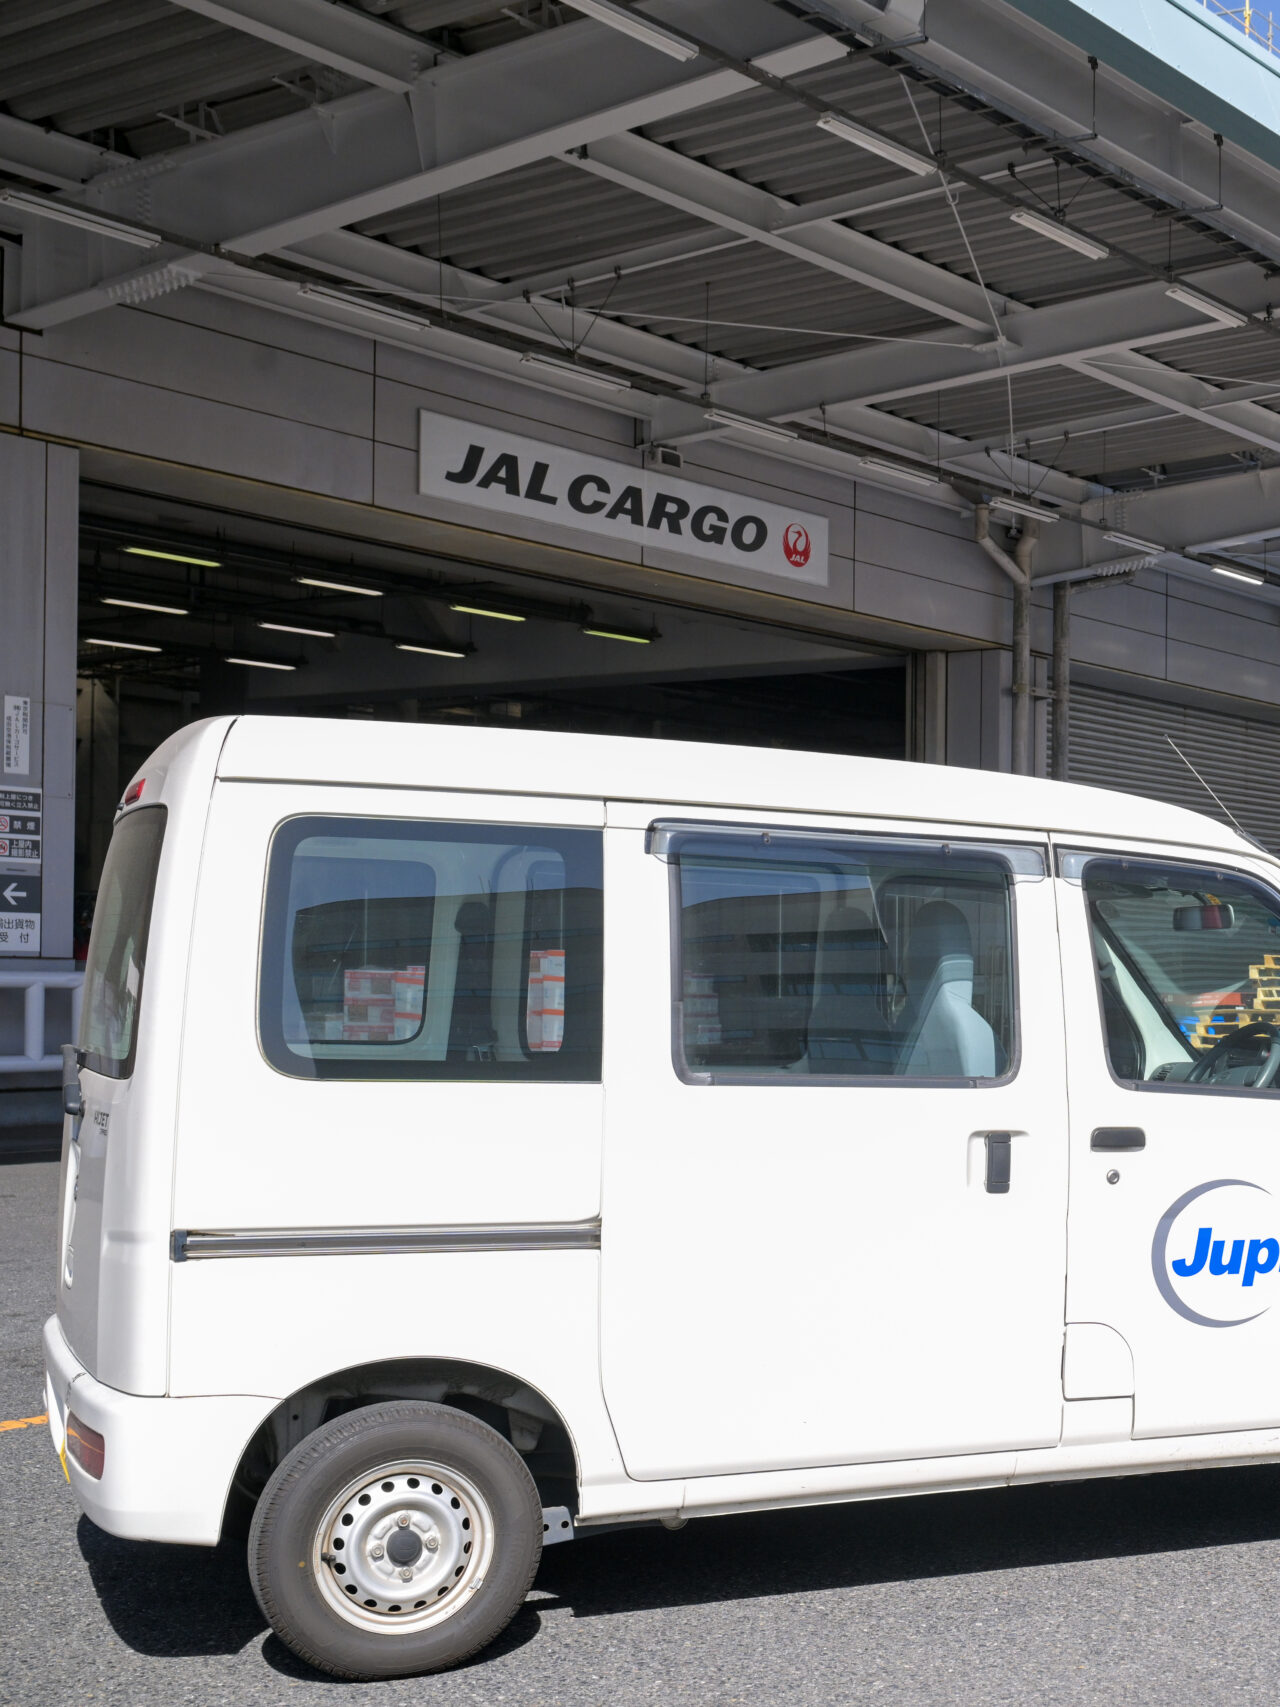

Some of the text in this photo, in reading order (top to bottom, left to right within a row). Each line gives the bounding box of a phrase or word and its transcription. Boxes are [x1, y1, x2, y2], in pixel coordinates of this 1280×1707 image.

[445, 444, 768, 552] JAL CARGO
[790, 554, 806, 564] JAL
